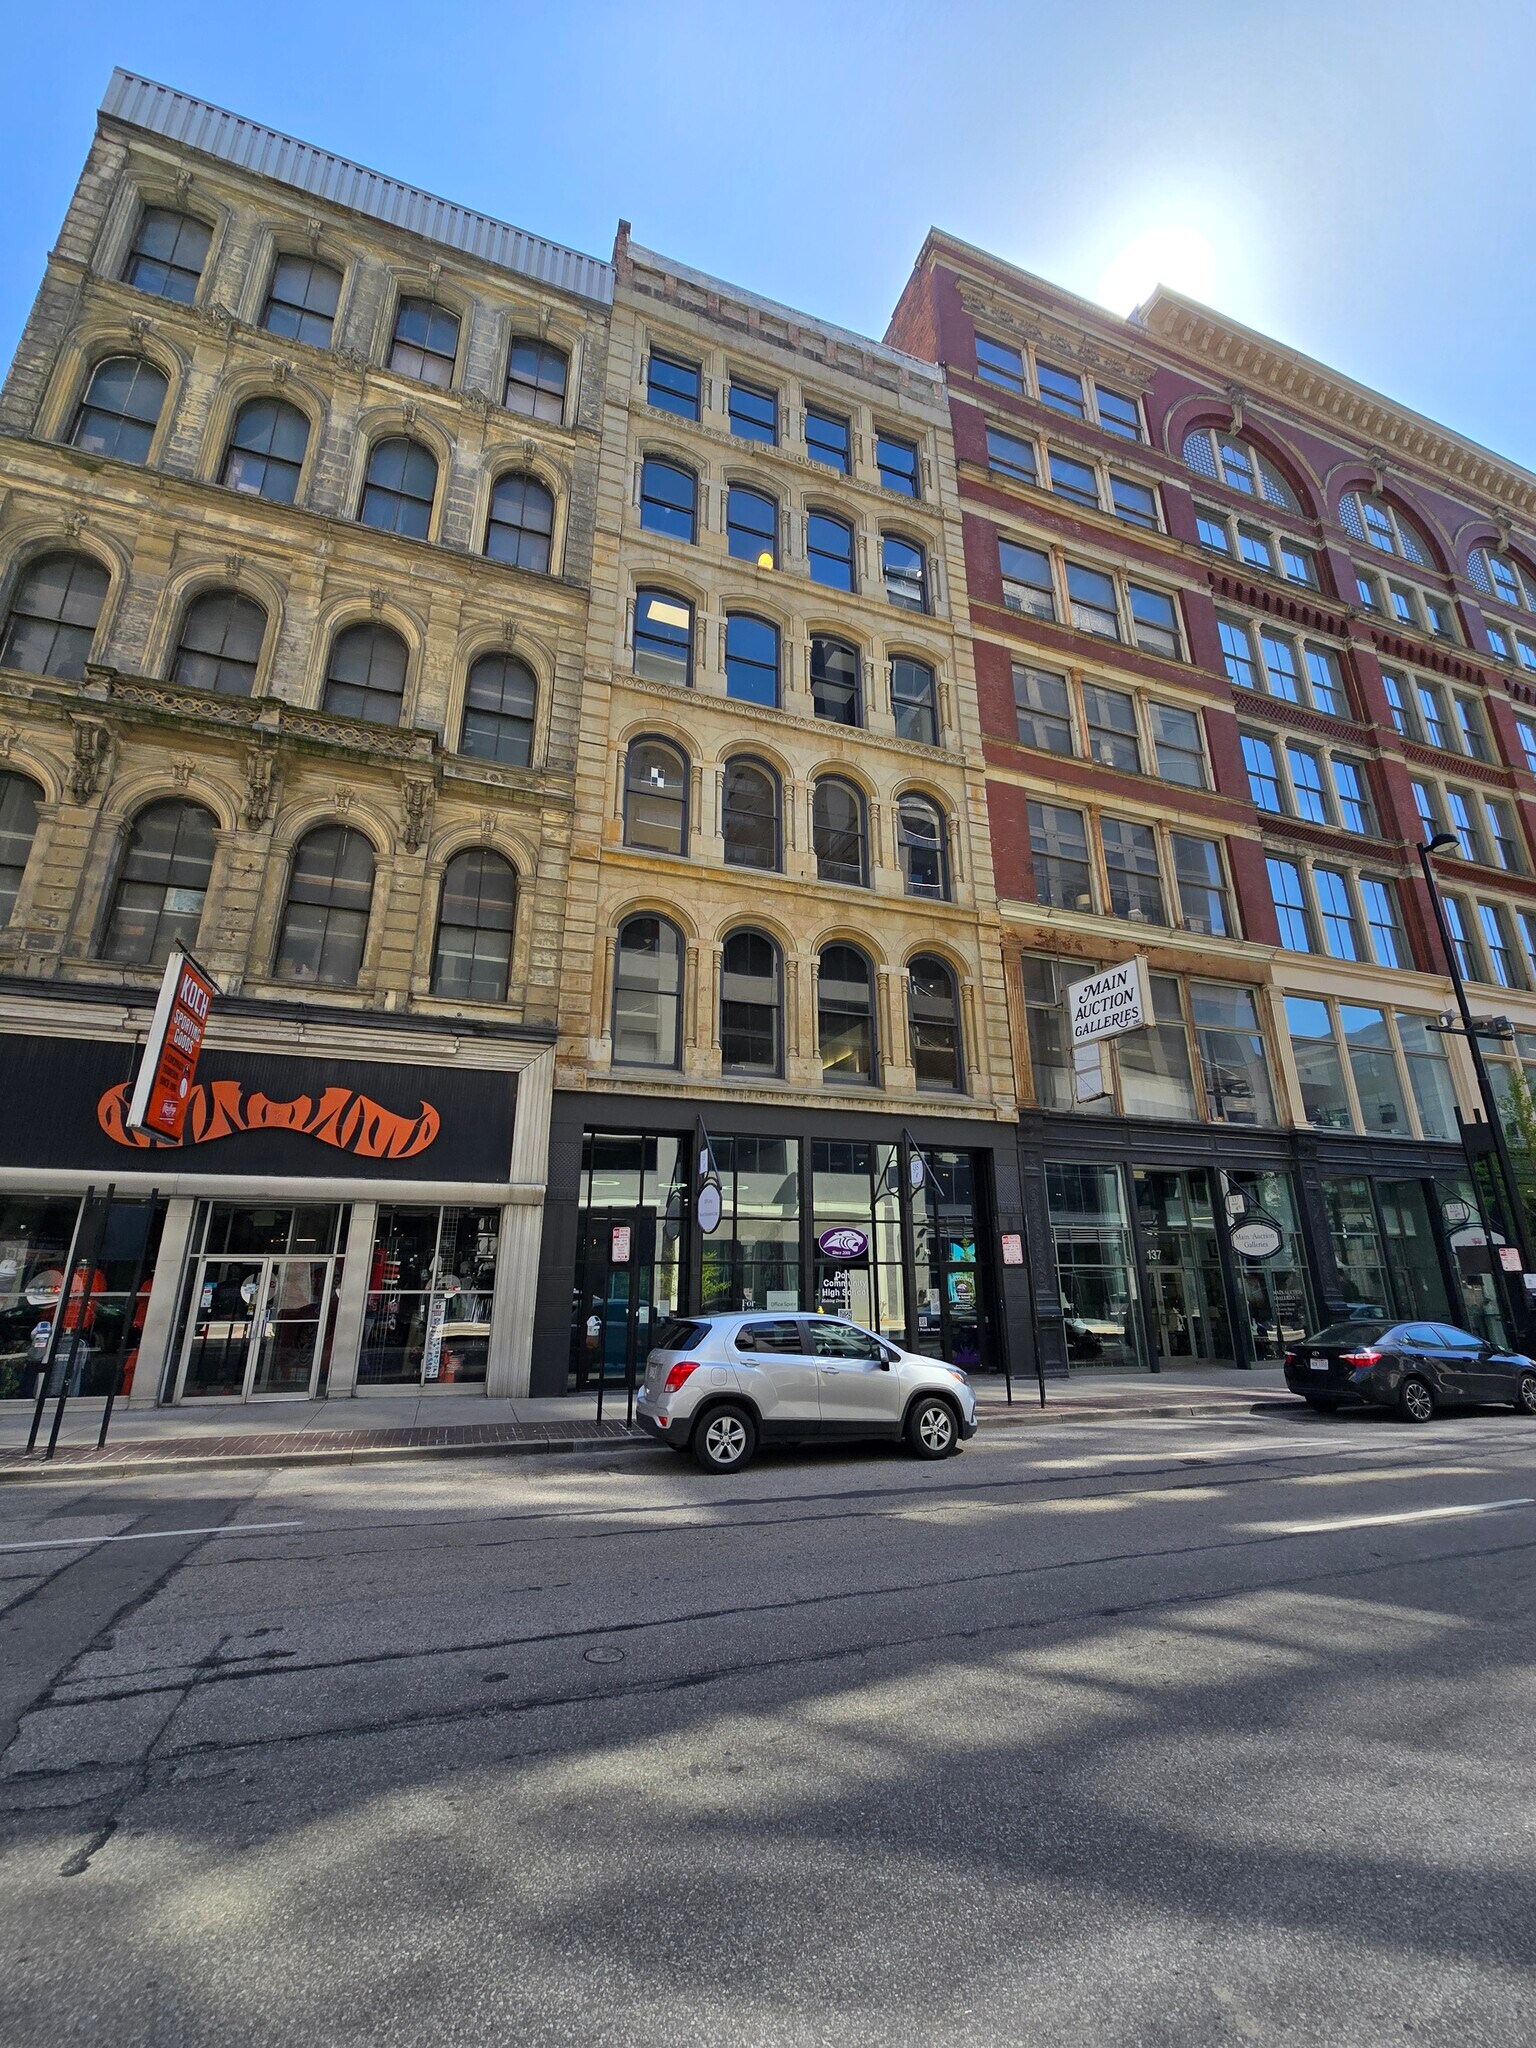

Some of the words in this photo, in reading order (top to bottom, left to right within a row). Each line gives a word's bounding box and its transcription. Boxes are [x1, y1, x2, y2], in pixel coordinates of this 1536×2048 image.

[179, 974, 210, 1020] KOCH
[1079, 970, 1128, 1003] MAIN
[1075, 987, 1134, 1021] AUCTION
[173, 1009, 201, 1043] SPORTING
[1075, 1006, 1139, 1037] GALLERIES
[173, 1030, 194, 1054] GOODS
[1253, 1232, 1275, 1240] Auction
[1146, 1250, 1162, 1260] 137
[742, 1299, 755, 1307] For
[822, 1288, 840, 1298] High
